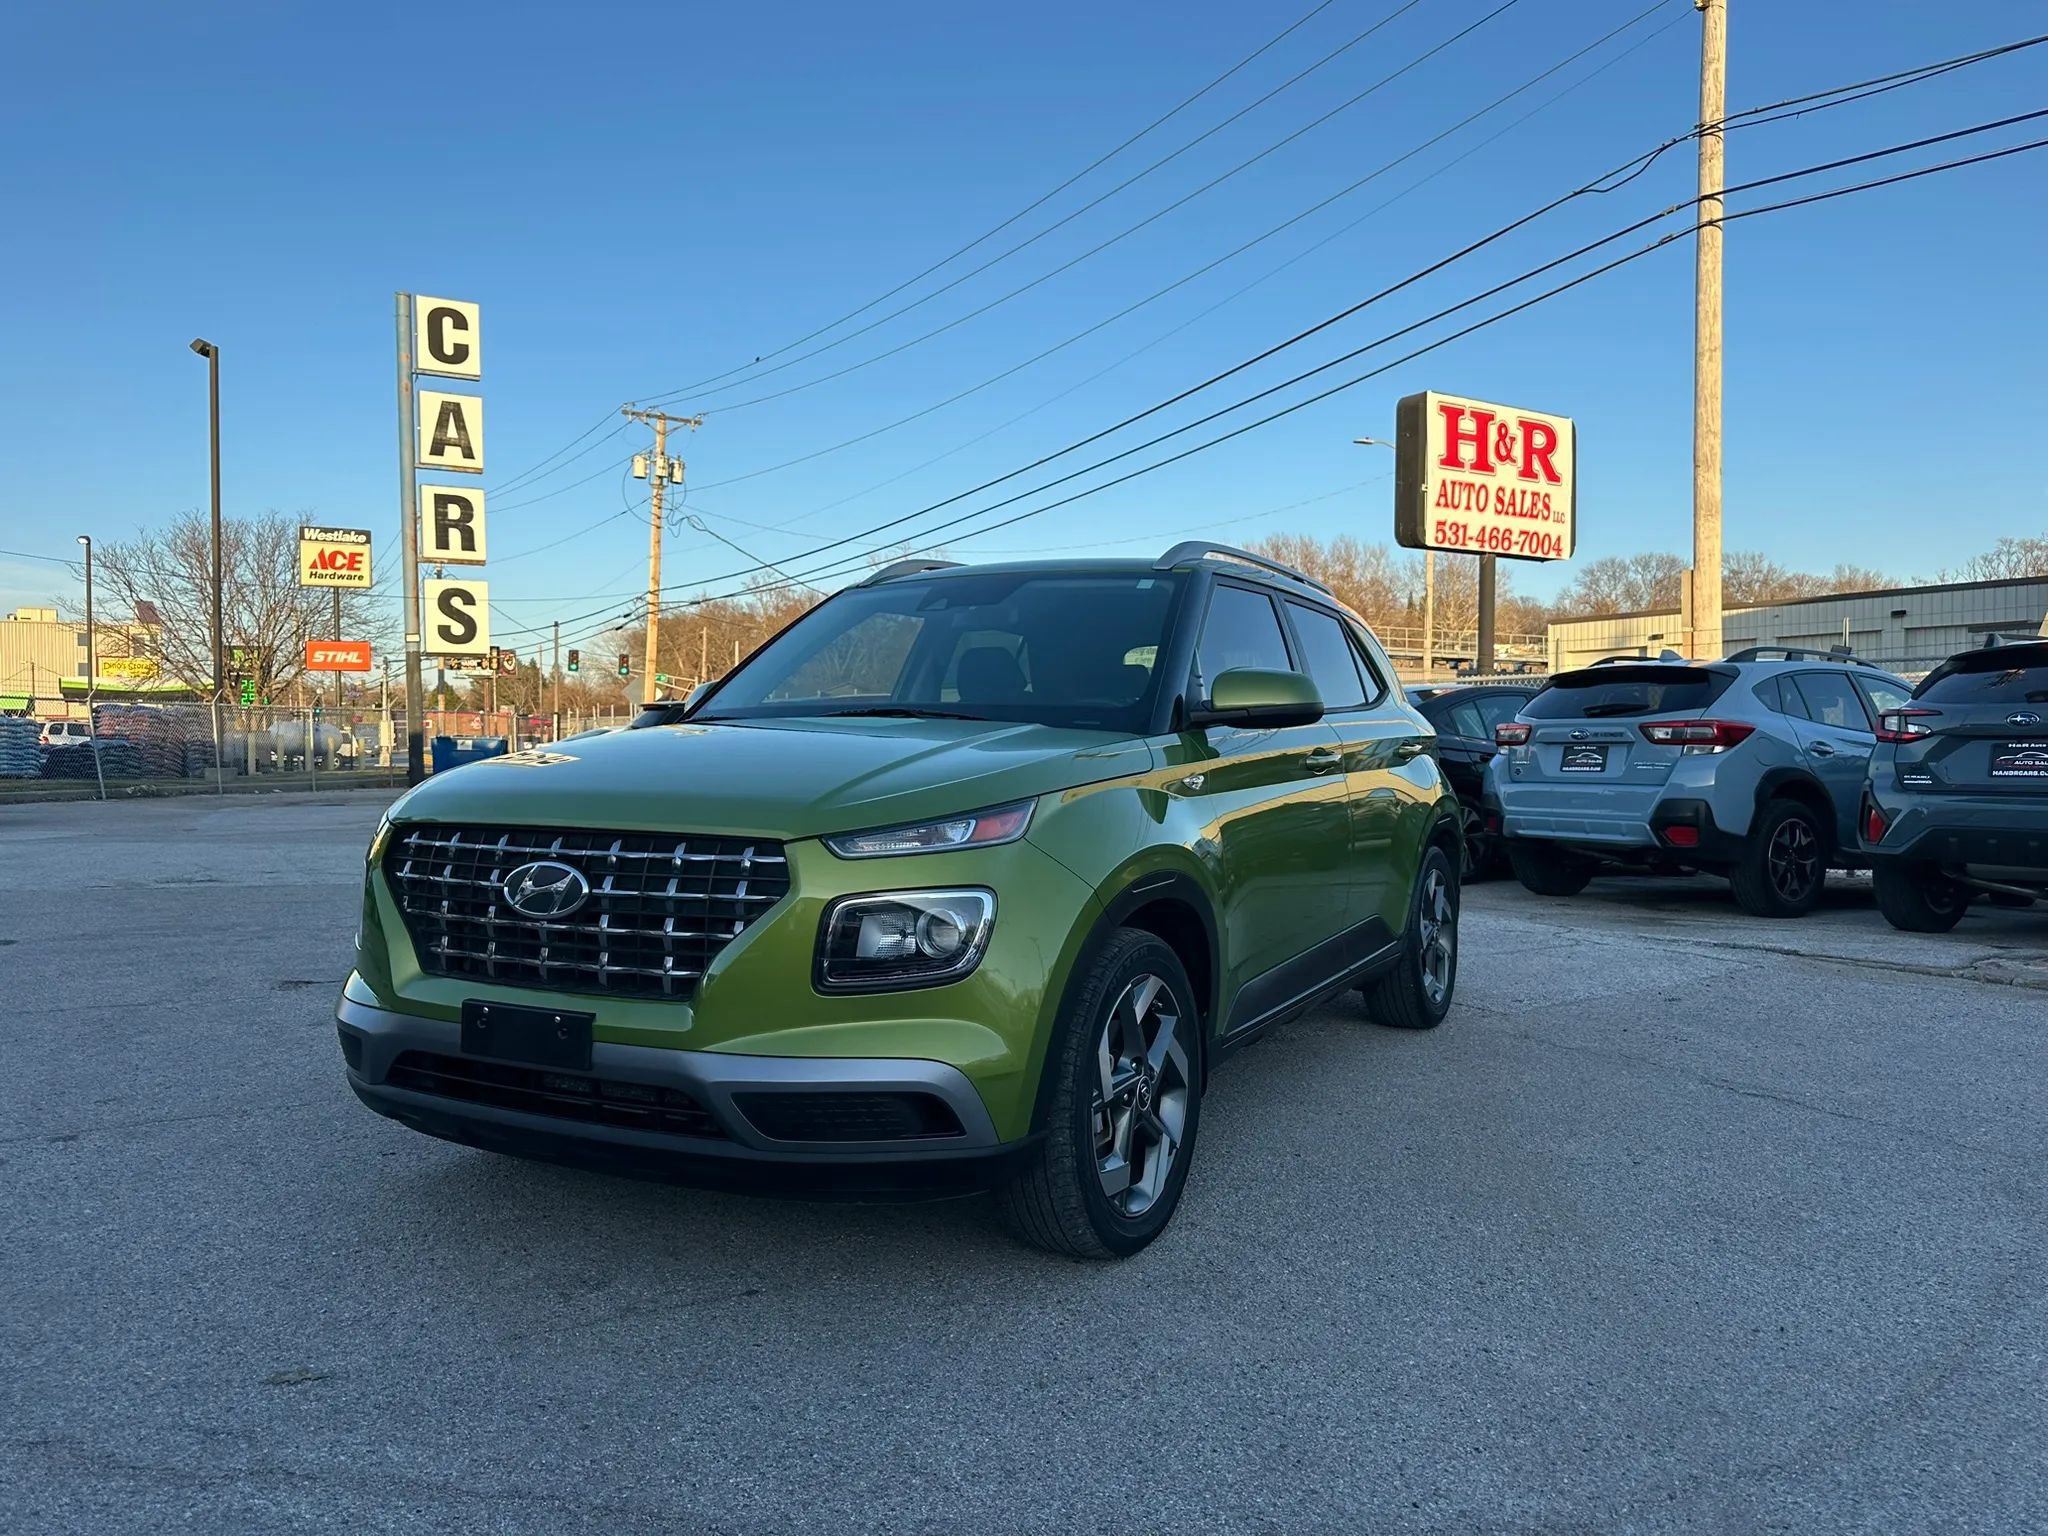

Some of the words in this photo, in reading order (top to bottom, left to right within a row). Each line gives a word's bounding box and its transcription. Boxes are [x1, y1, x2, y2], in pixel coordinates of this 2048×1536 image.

[1438, 402, 1562, 485] H&R
[1435, 479, 1489, 513] AUTO
[1494, 485, 1551, 521] SALES
[1553, 511, 1565, 524] LLC
[304, 528, 367, 543] Westlake
[1434, 519, 1563, 557] 531-466-7004
[309, 547, 364, 571] ACE
[309, 571, 364, 581] Hardware
[103, 662, 126, 670] Dino's
[312, 650, 363, 663] STIHL
